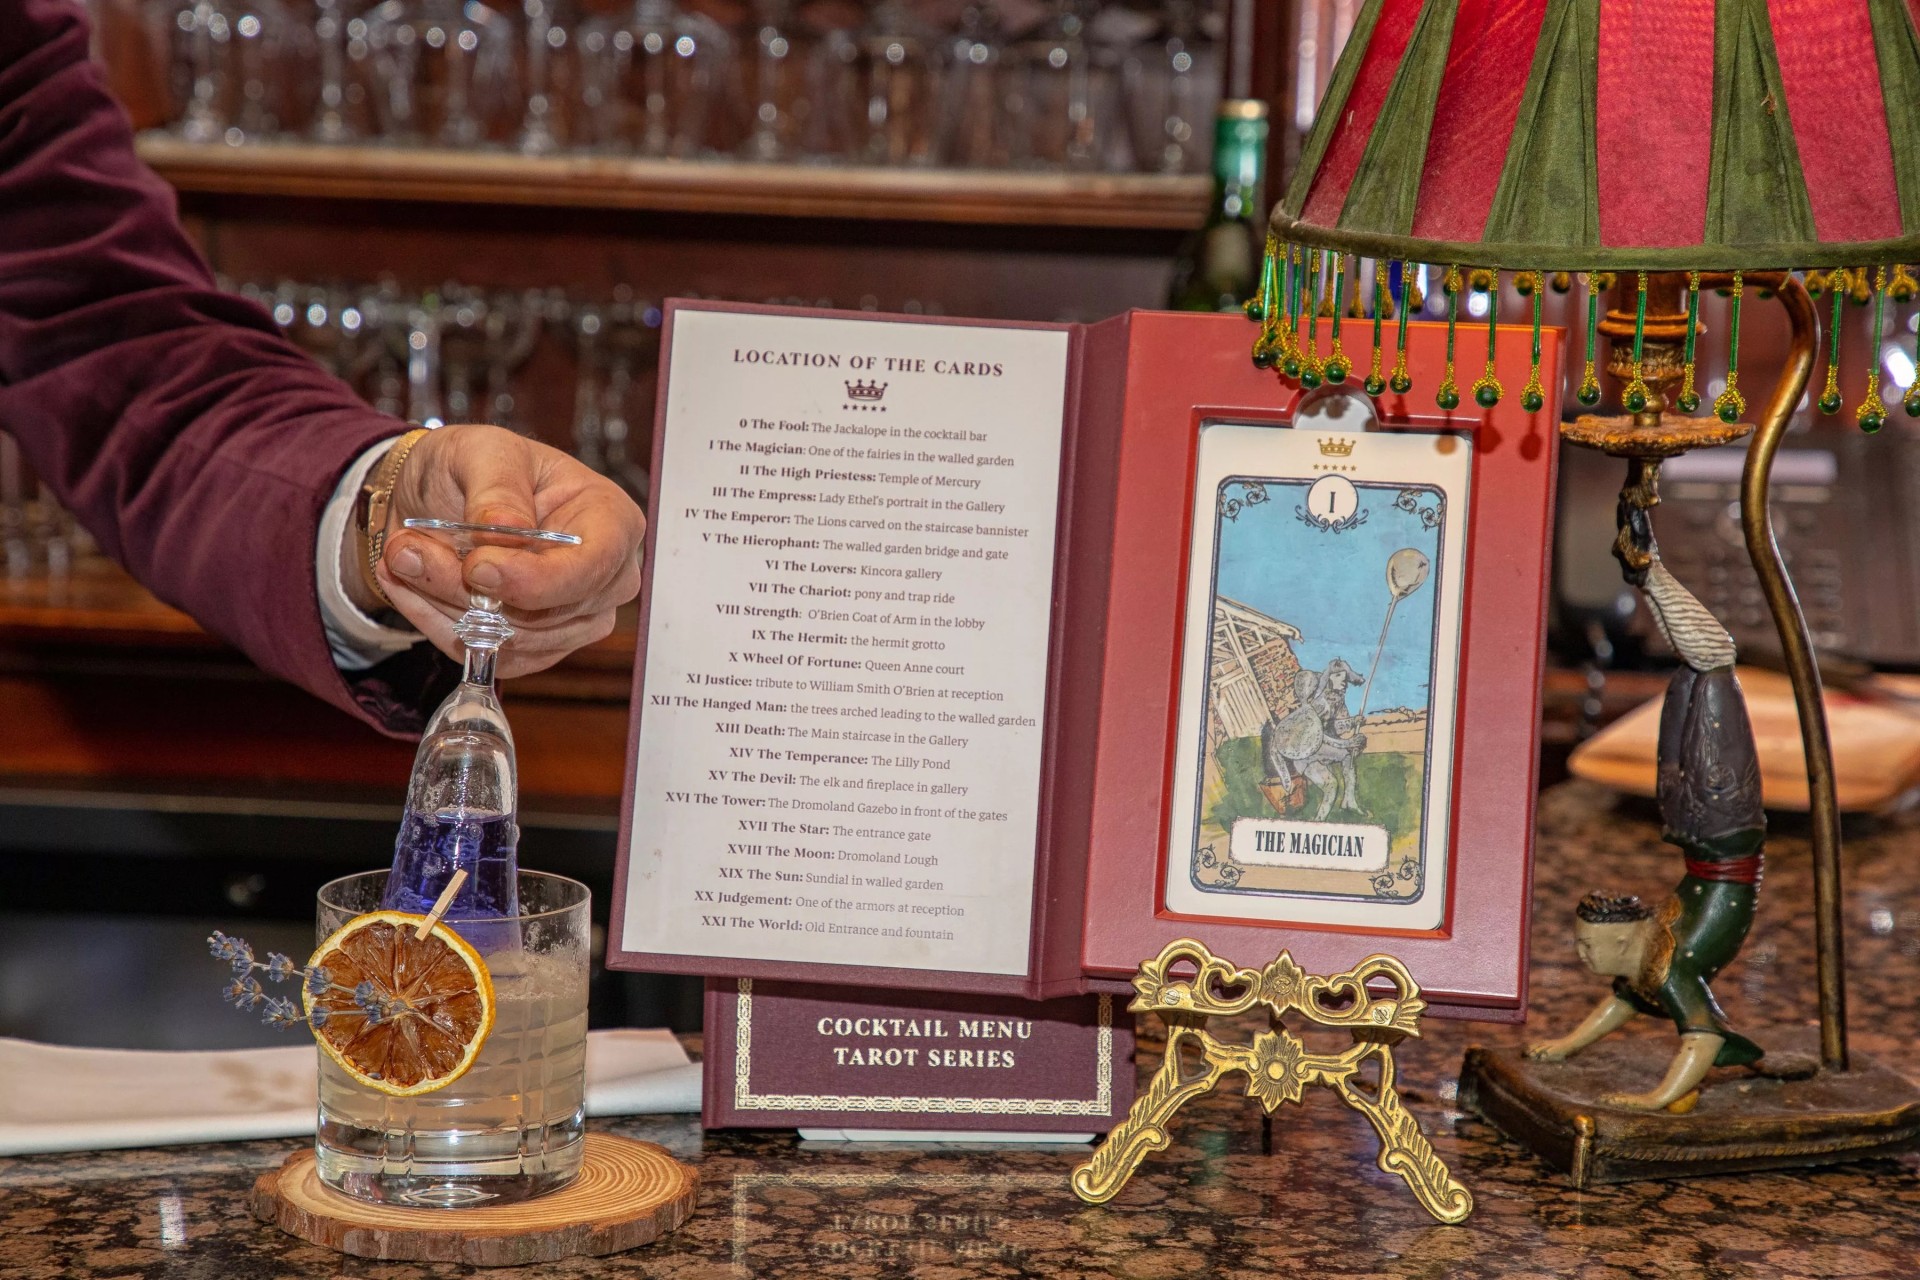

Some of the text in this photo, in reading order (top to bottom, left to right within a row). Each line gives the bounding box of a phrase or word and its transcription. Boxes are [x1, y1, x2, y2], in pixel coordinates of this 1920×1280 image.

[733, 348, 1003, 377] LOCATION OF THE CARDS
[738, 418, 987, 442] 0 The Fool: The Jackalope in the cocktail bar
[708, 439, 1014, 467] I The Magician: One of the fairies in the walled garden
[739, 464, 981, 490] II The High Priestess: Temple of Mercury
[712, 486, 727, 497] III
[730, 487, 755, 498] The
[758, 488, 816, 503] Empress:
[819, 492, 845, 506] Lady
[886, 497, 928, 508] portrait
[931, 498, 942, 509] in
[945, 499, 963, 510] the
[965, 500, 1005, 514] Gallery
[1329, 491, 1336, 513] I
[684, 507, 1029, 537] IV The Emperor: The Lions carved on the staircase bannister
[702, 532, 1009, 560] V The Hierophant: The walled garden bridge and gate
[765, 559, 942, 581] VI The Lovers: Kincora gallery
[748, 582, 955, 604] VII The Chariot: pony and trap ride
[715, 603, 740, 615] VIII
[743, 605, 802, 621] Strength:
[852, 611, 877, 623] Coat
[879, 613, 892, 623] of
[892, 614, 917, 625] Arm
[919, 615, 931, 626] in
[934, 616, 952, 627] the
[954, 616, 985, 631] lobby
[751, 629, 945, 651] IX The Hermit: the hermit grotto
[728, 651, 964, 675] X Wheel Of Fortune: Queen Anne court
[686, 672, 701, 684] XI
[704, 674, 752, 686] Justice:
[755, 677, 793, 689] tribute
[795, 680, 807, 690] to
[809, 680, 854, 692] William
[856, 682, 890, 694] Smith
[937, 688, 949, 698] at
[951, 689, 1003, 701] reception
[714, 722, 968, 748] XIII Death: The Main staircase in the Gallery
[729, 746, 950, 769] XIV The Temperance: The Lilly Pond
[708, 770, 968, 796] XV The Devil: The elk and fireplace in gallery
[738, 819, 931, 842] XVII The Star: The entrance gate
[727, 843, 938, 867] XVIII The Moon: Dromoland Lough
[1255, 830, 1365, 858] THE MAGICIAN
[718, 867, 943, 890] XIX The Sun: Sundial in walled garden
[817, 1017, 1033, 1039] COCKTAIL MENU
[834, 1047, 1016, 1069] TAROT SERIES
